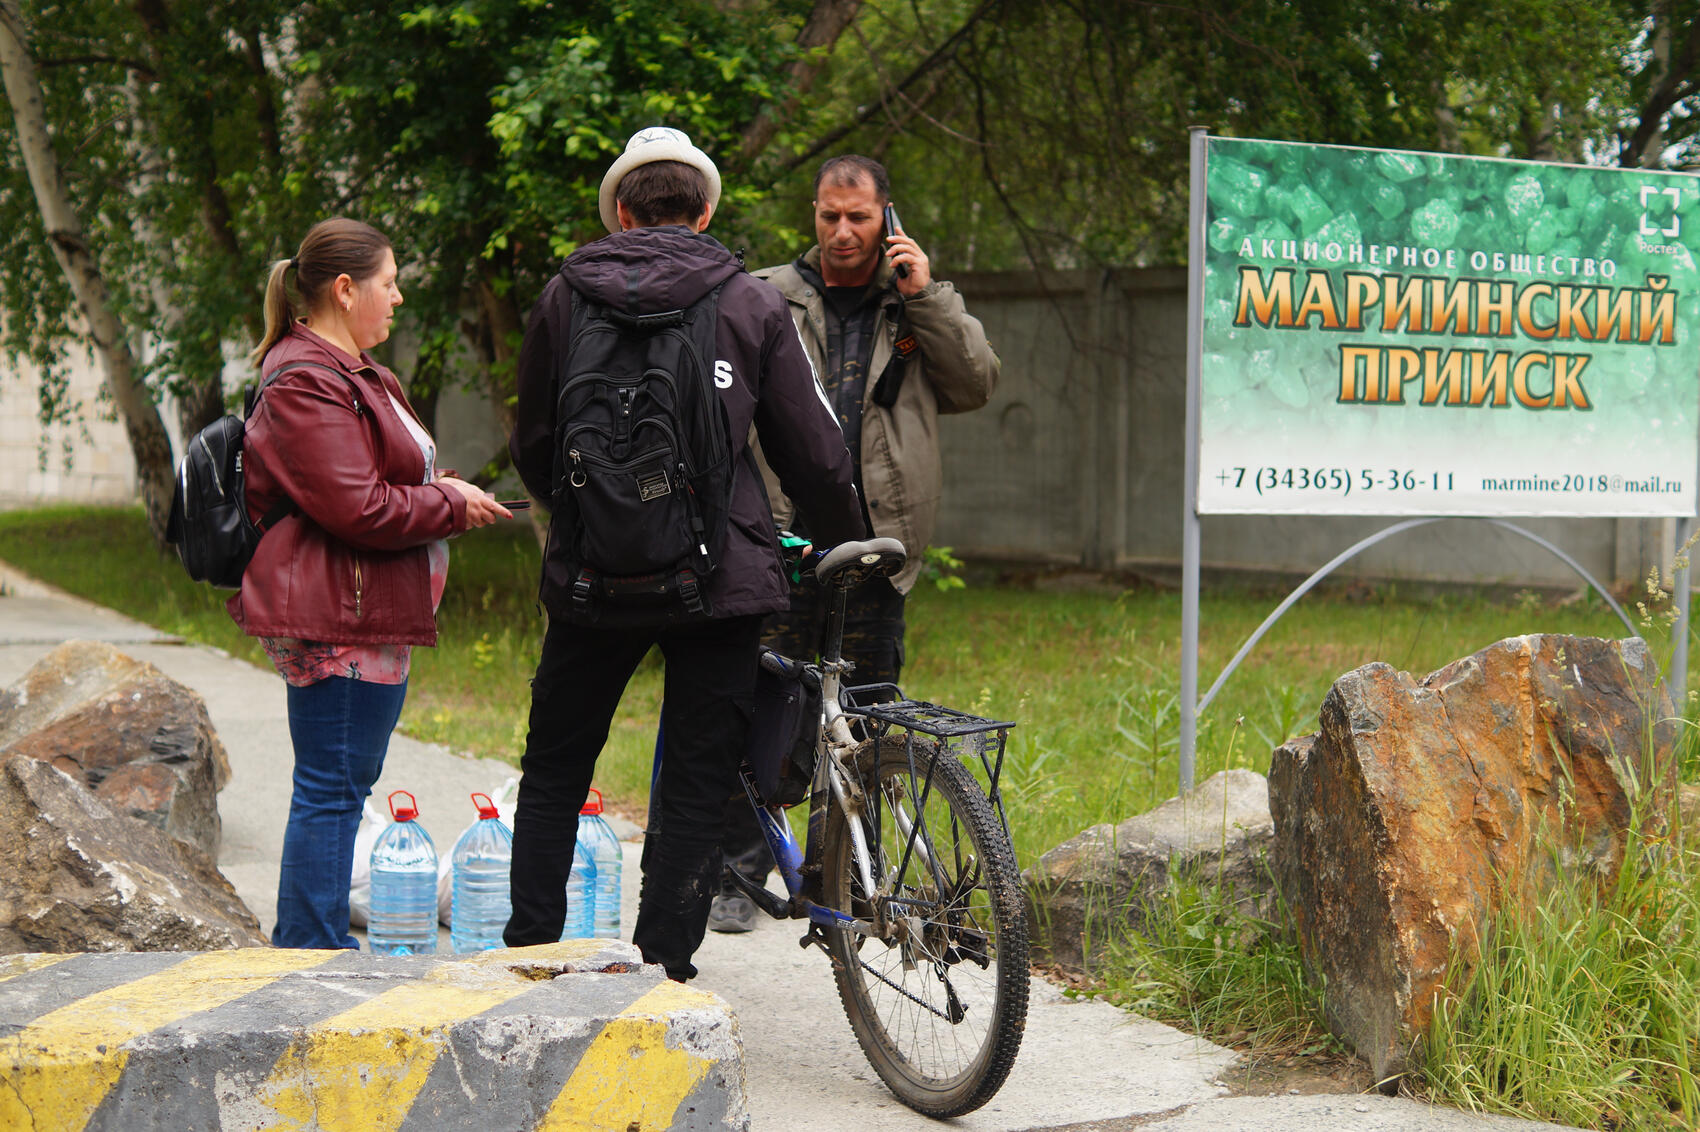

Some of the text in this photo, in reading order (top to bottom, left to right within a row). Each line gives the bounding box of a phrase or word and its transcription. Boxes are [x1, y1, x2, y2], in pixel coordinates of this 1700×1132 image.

[1238, 237, 1617, 278] АКЦИОНЕРНОЕ ОБЩЕСТВО
[1639, 241, 1680, 254] Ростех
[1232, 265, 1679, 346] МАРИИНСКИЙ
[1336, 343, 1594, 412] ПРИИСК
[1215, 467, 1454, 496] +7 (34365) 5-36-11
[1481, 474, 1682, 493] marmine2018@mail.ru
